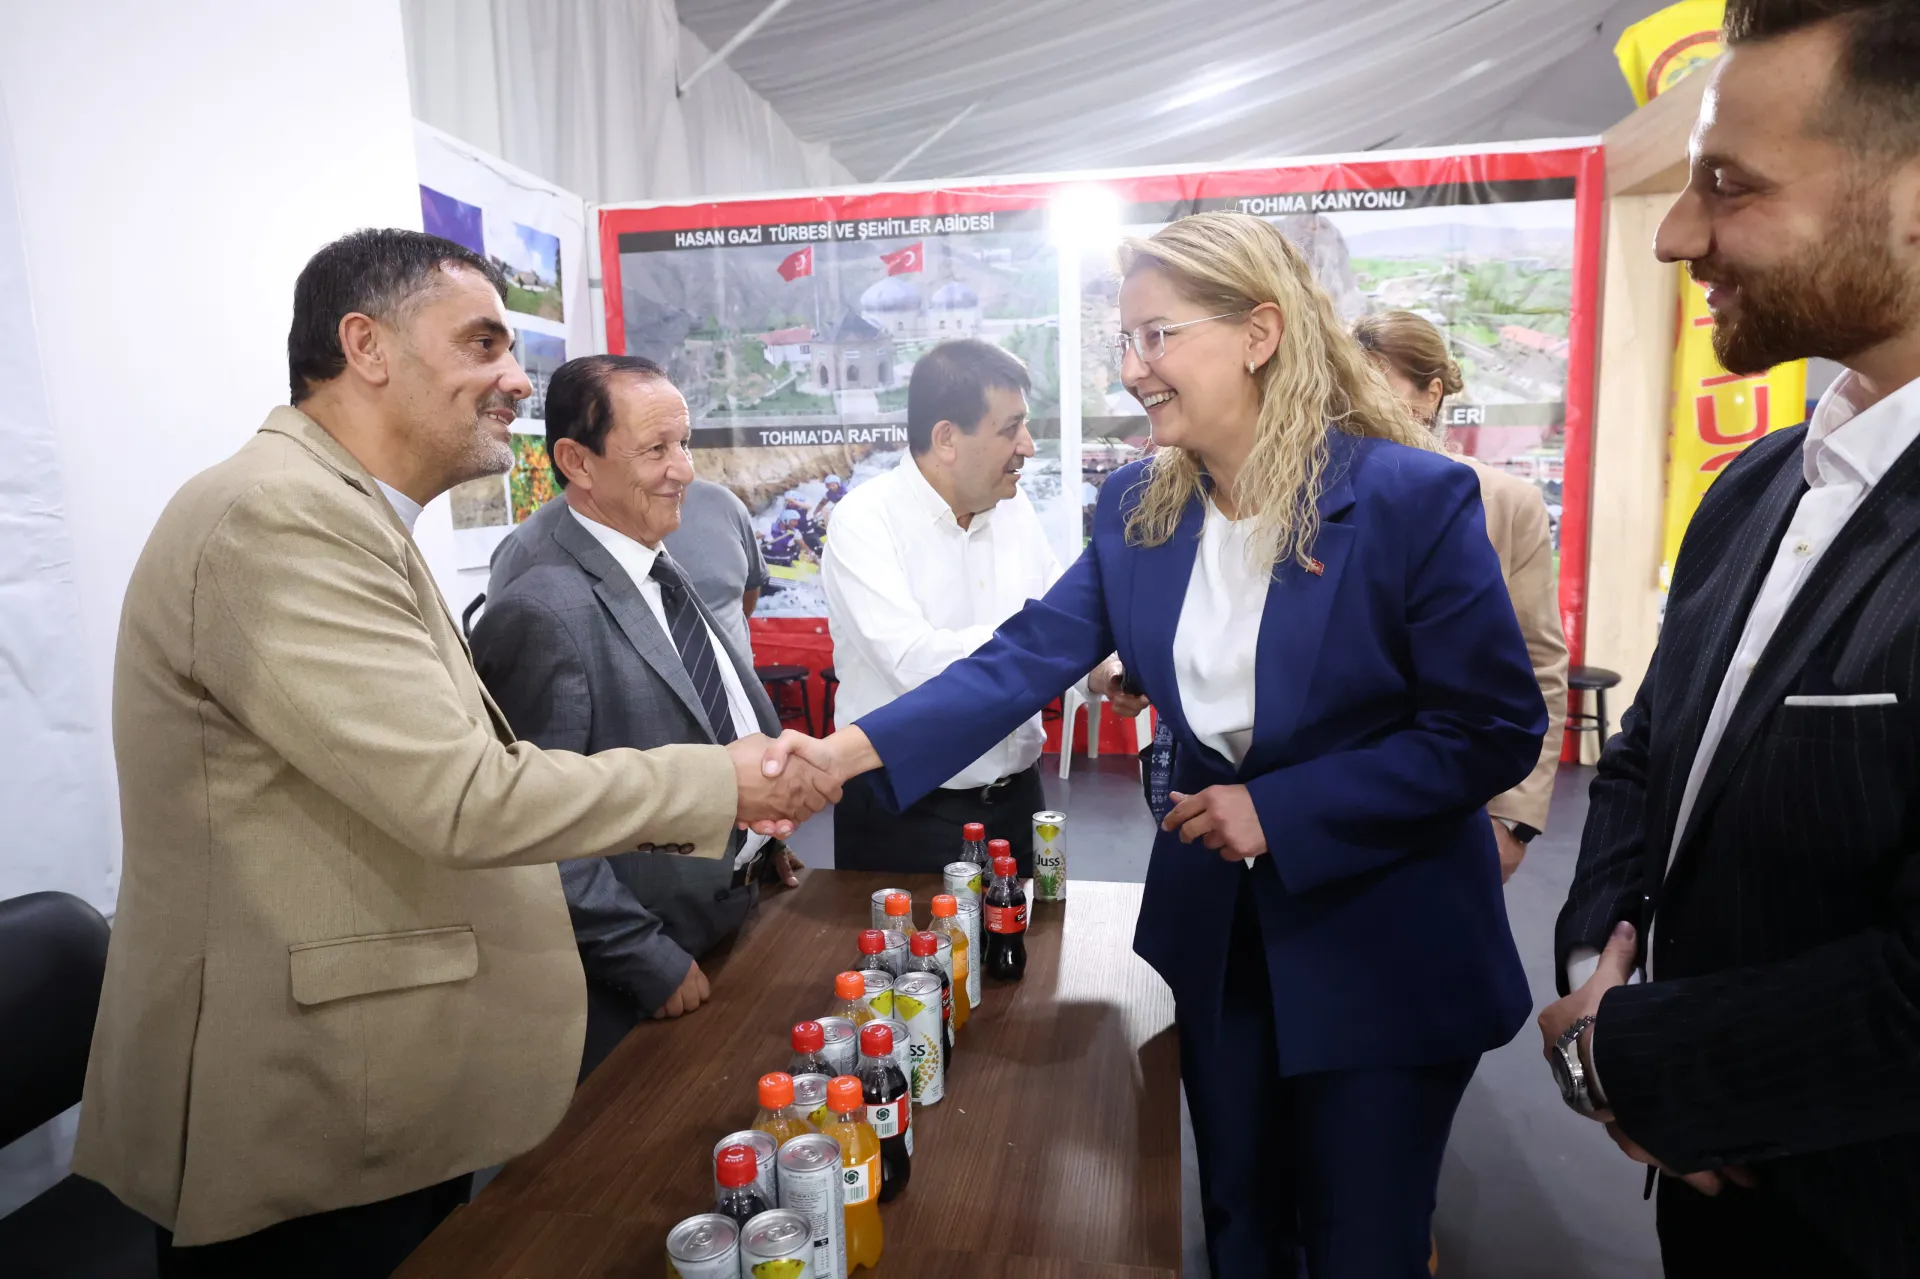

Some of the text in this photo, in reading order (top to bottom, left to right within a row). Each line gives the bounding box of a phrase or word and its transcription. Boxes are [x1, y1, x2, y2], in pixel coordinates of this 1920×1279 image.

[1239, 191, 1406, 214] TOHMA KANYONU
[675, 212, 994, 247] HASAN GAZİ TÜRBESİ VE ŞEHİTLER ABİDESİ
[1442, 403, 1486, 424] LERİ
[848, 425, 907, 443] RAFTİN
[1036, 854, 1060, 867] Juss
[910, 1044, 926, 1057] ss
